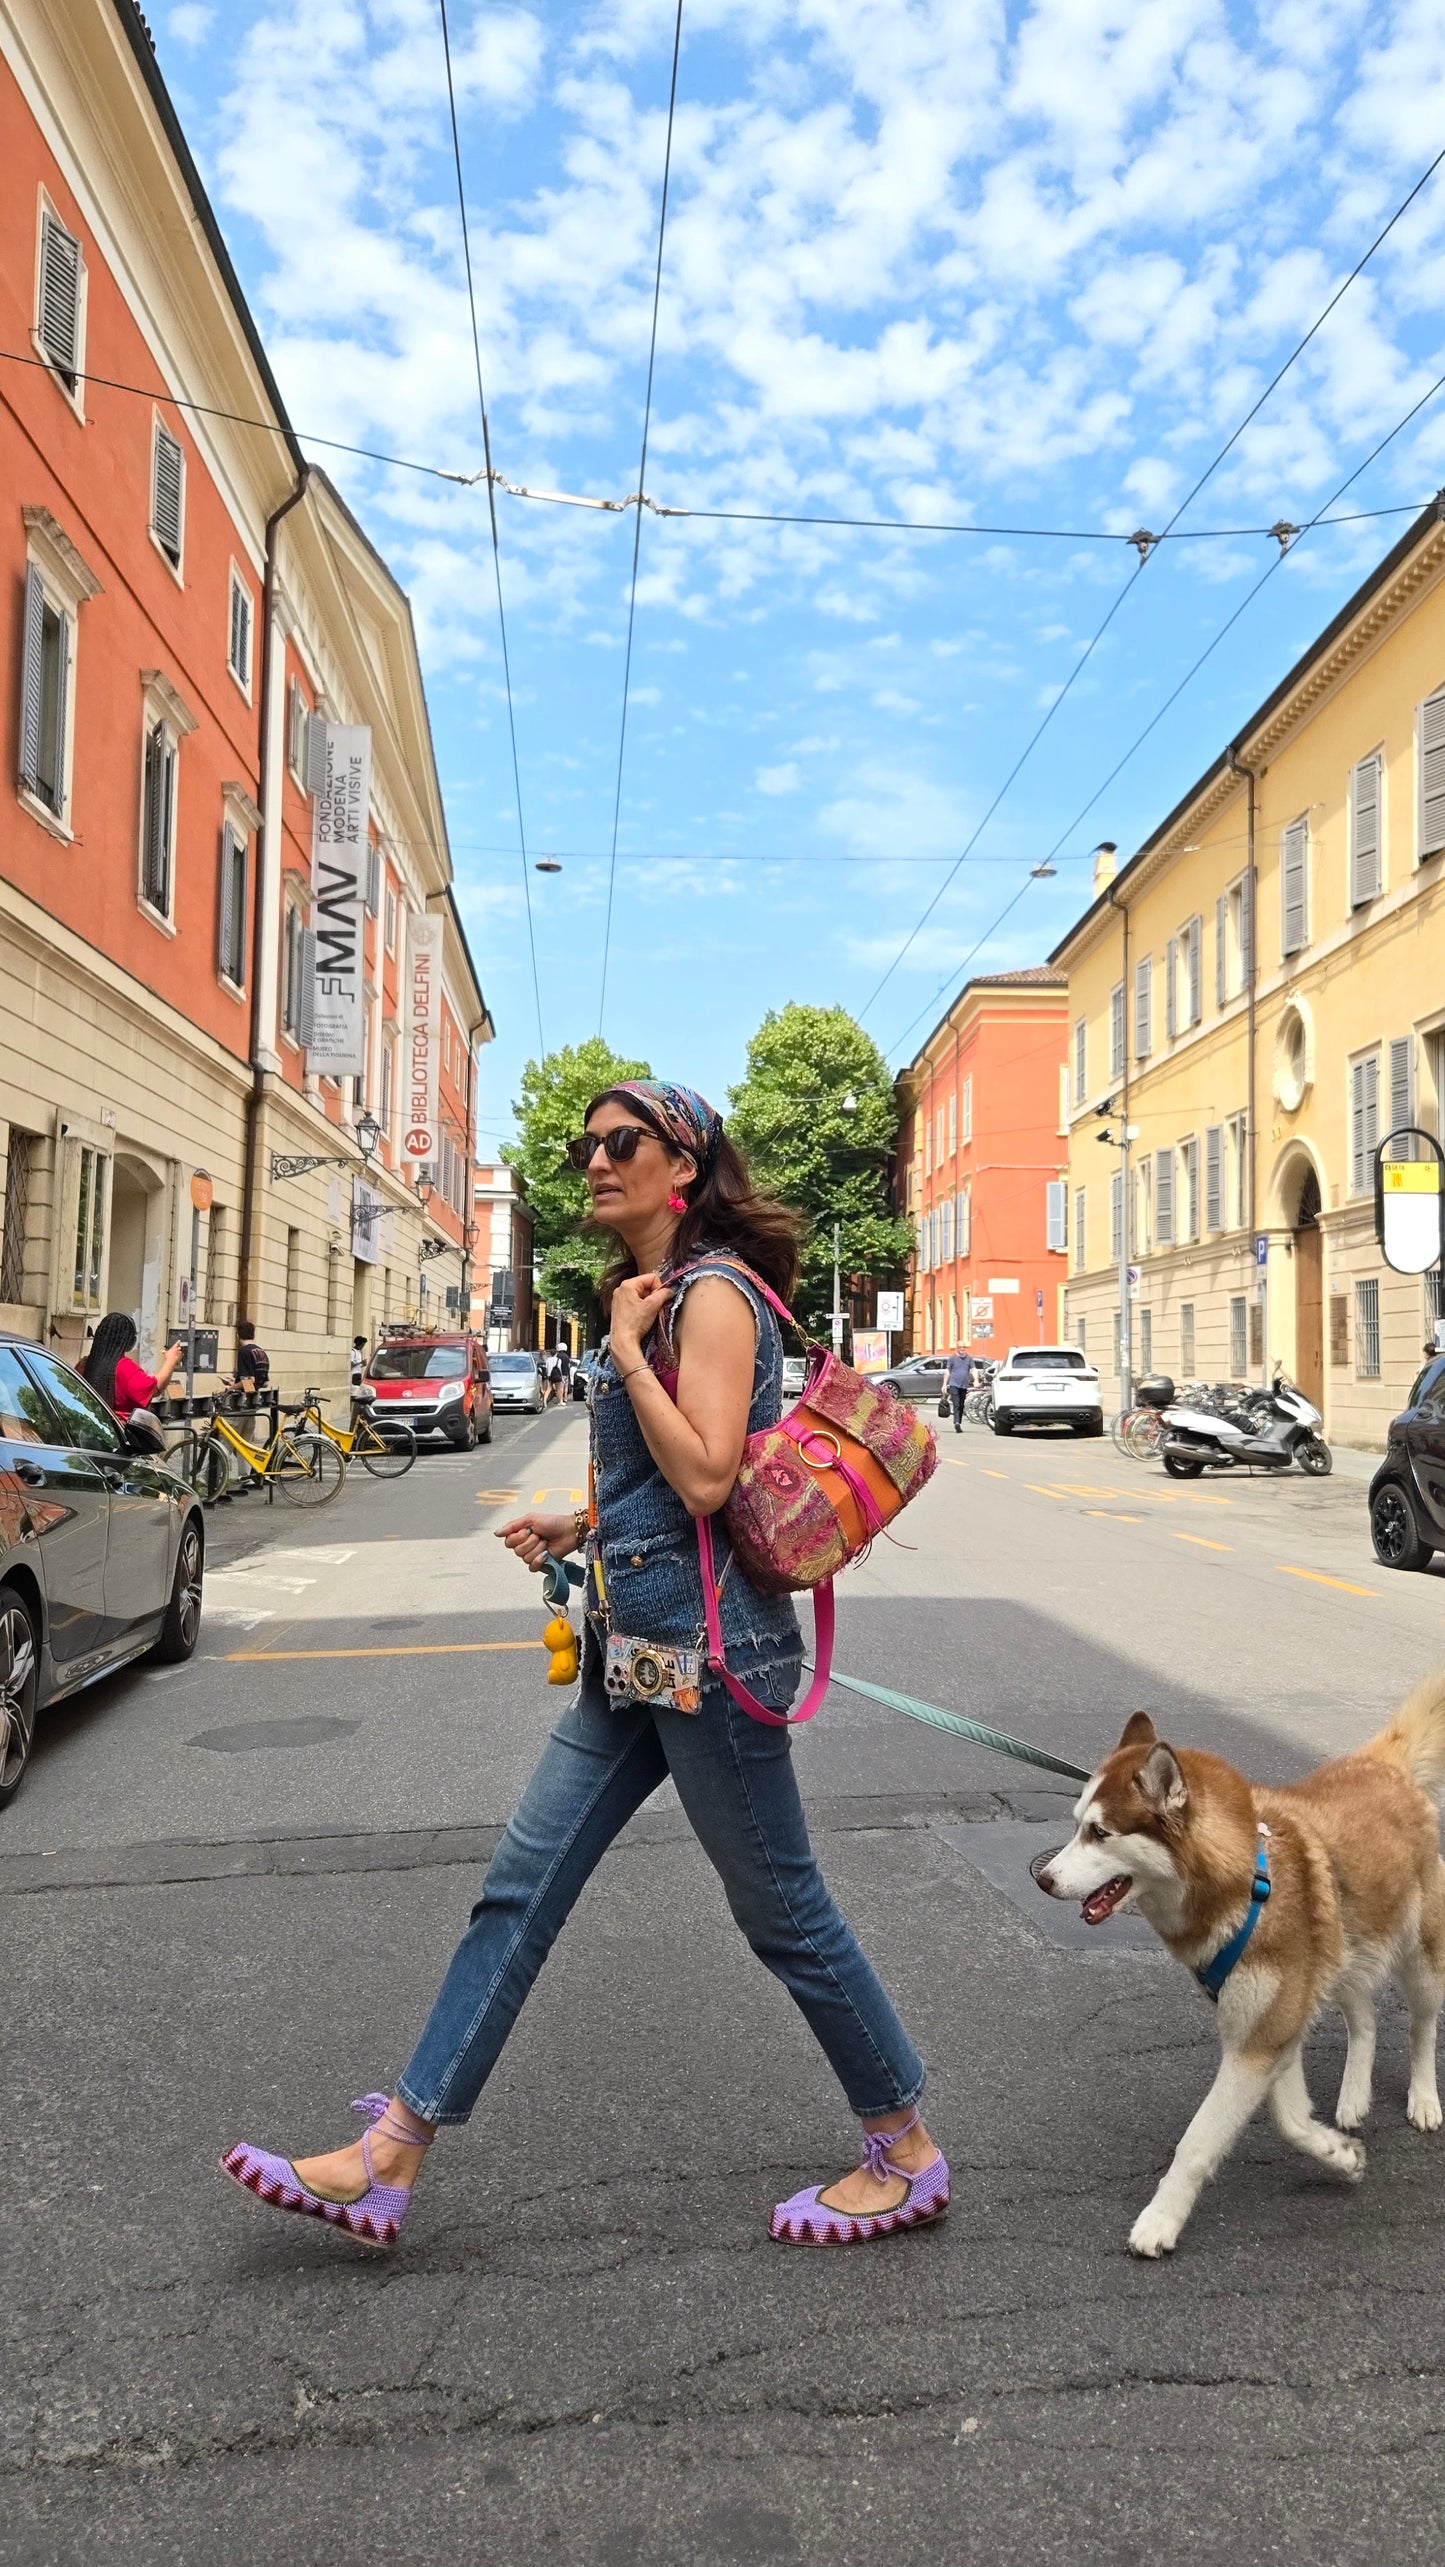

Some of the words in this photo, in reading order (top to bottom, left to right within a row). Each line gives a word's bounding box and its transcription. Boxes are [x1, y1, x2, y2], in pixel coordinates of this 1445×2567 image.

[348, 756, 362, 805] VISIVE
[333, 774, 347, 843] MODENA
[347, 810, 360, 844] ARTI
[413, 953, 431, 1018] DELFINI
[411, 1022, 429, 1125] BIBLIOTECA
[406, 1134, 431, 1150] AD
[1258, 1240, 1265, 1263] P
